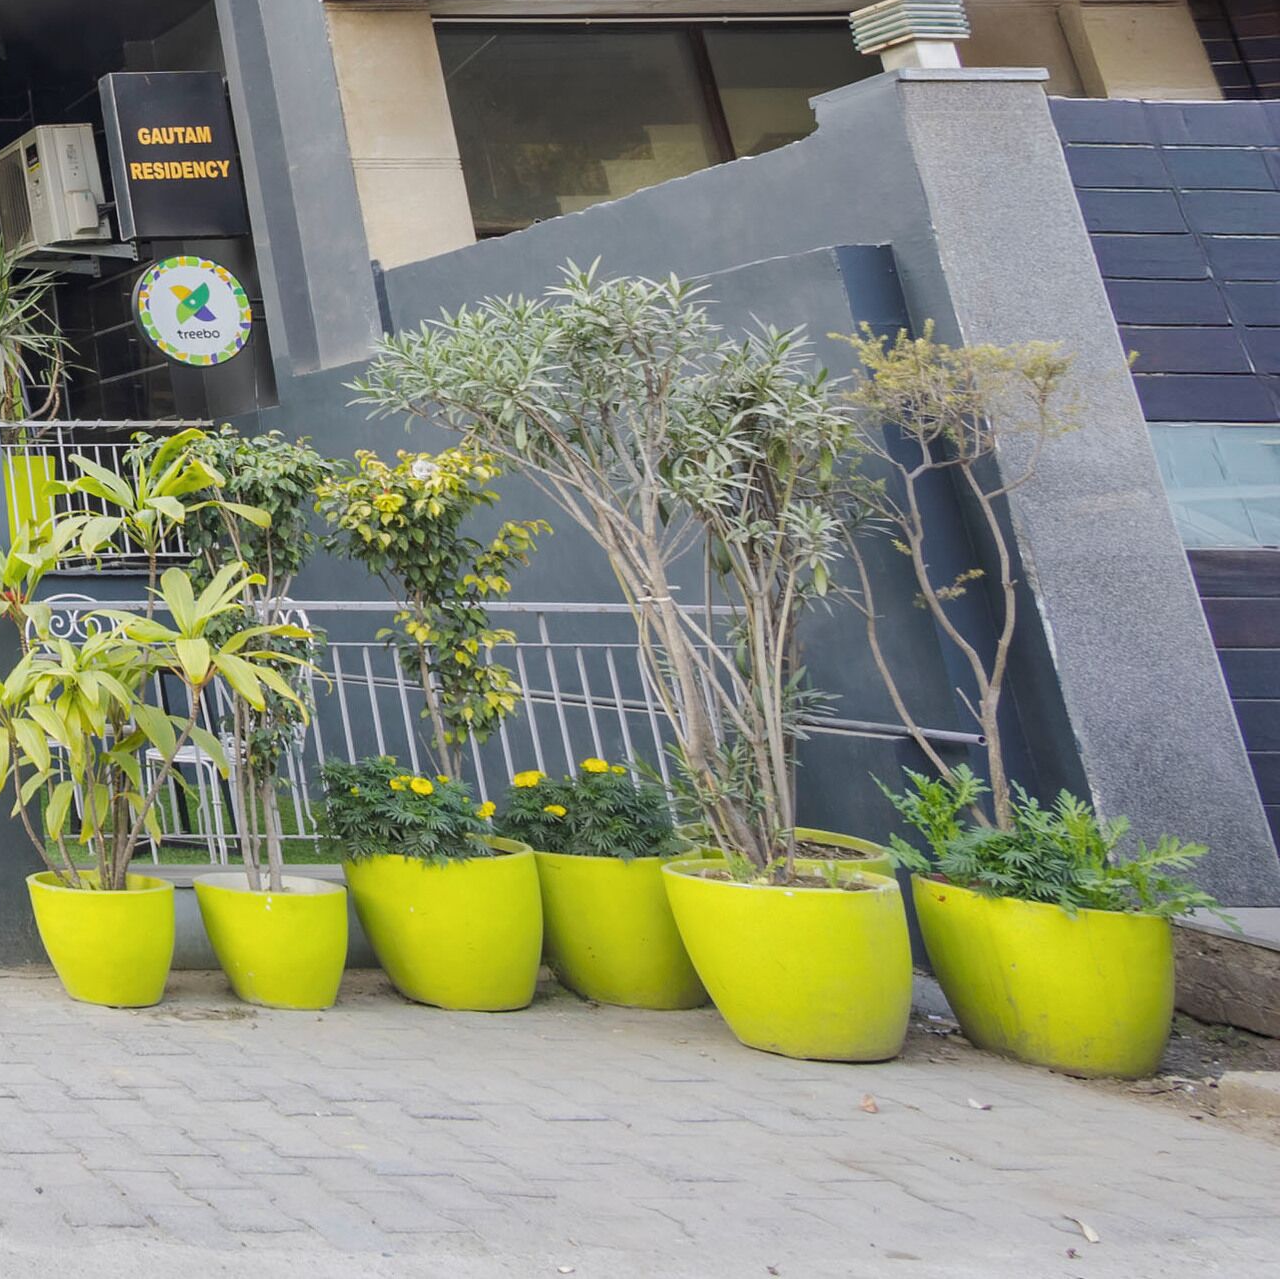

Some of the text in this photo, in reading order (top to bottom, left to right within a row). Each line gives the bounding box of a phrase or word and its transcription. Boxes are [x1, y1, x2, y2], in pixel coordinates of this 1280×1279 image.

[137, 126, 212, 145] GAUTAM
[130, 160, 230, 180] RESIDENCY
[177, 329, 220, 339] treebo
